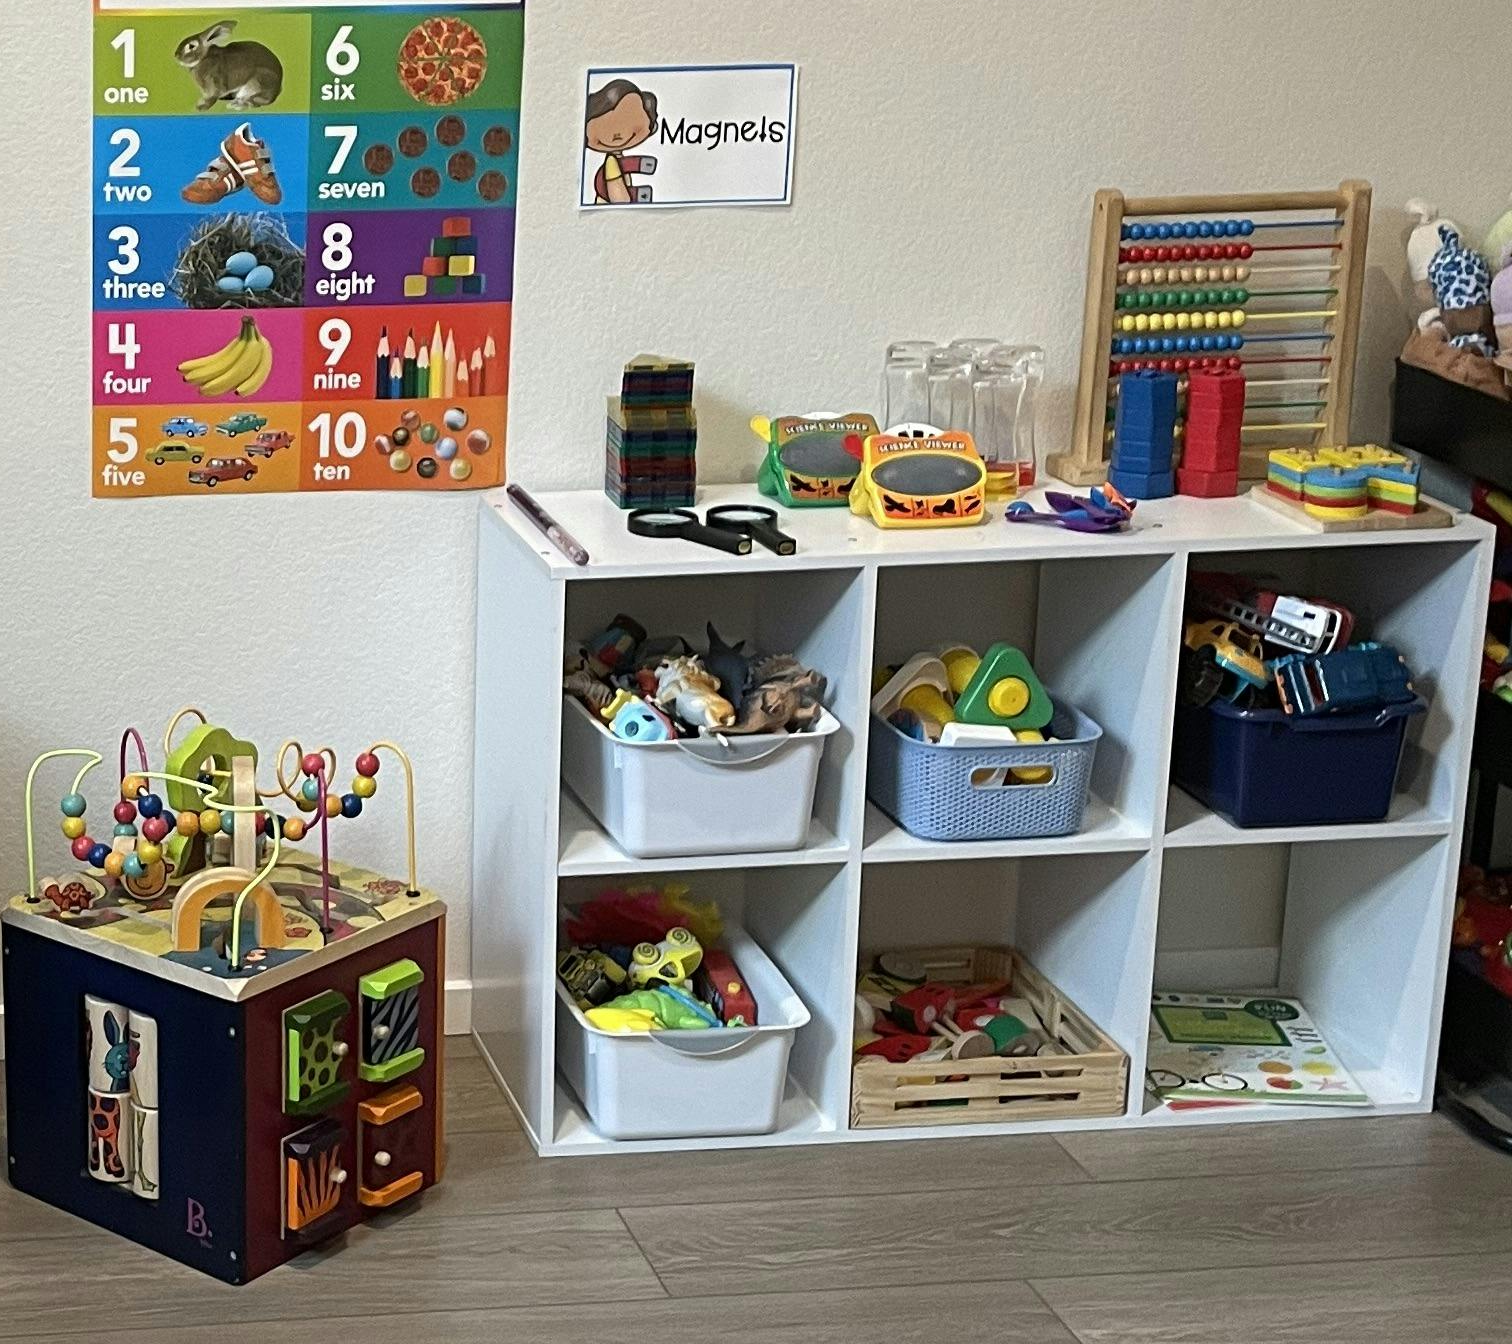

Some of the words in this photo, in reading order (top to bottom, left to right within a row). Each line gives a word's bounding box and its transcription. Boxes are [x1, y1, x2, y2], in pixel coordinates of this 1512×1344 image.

[110, 28, 136, 79] 1
[325, 26, 360, 77] 6
[103, 85, 149, 105] one
[320, 79, 356, 102] six
[659, 113, 785, 150] Magnets
[108, 127, 142, 177] 2
[324, 125, 358, 175] 7
[103, 182, 152, 203] two
[318, 180, 386, 200] seven
[107, 226, 140, 275] 3
[320, 222, 354, 272] 8
[103, 277, 166, 299] three
[315, 273, 375, 302] eight
[107, 322, 141, 371] 4
[317, 317, 353, 368] 9
[103, 373, 152, 395] four
[313, 370, 362, 391] nine
[107, 417, 139, 466] 5
[308, 412, 367, 459] 10
[922, 439, 966, 451] VIEWER
[101, 466, 145, 487] five
[313, 462, 351, 482] ten
